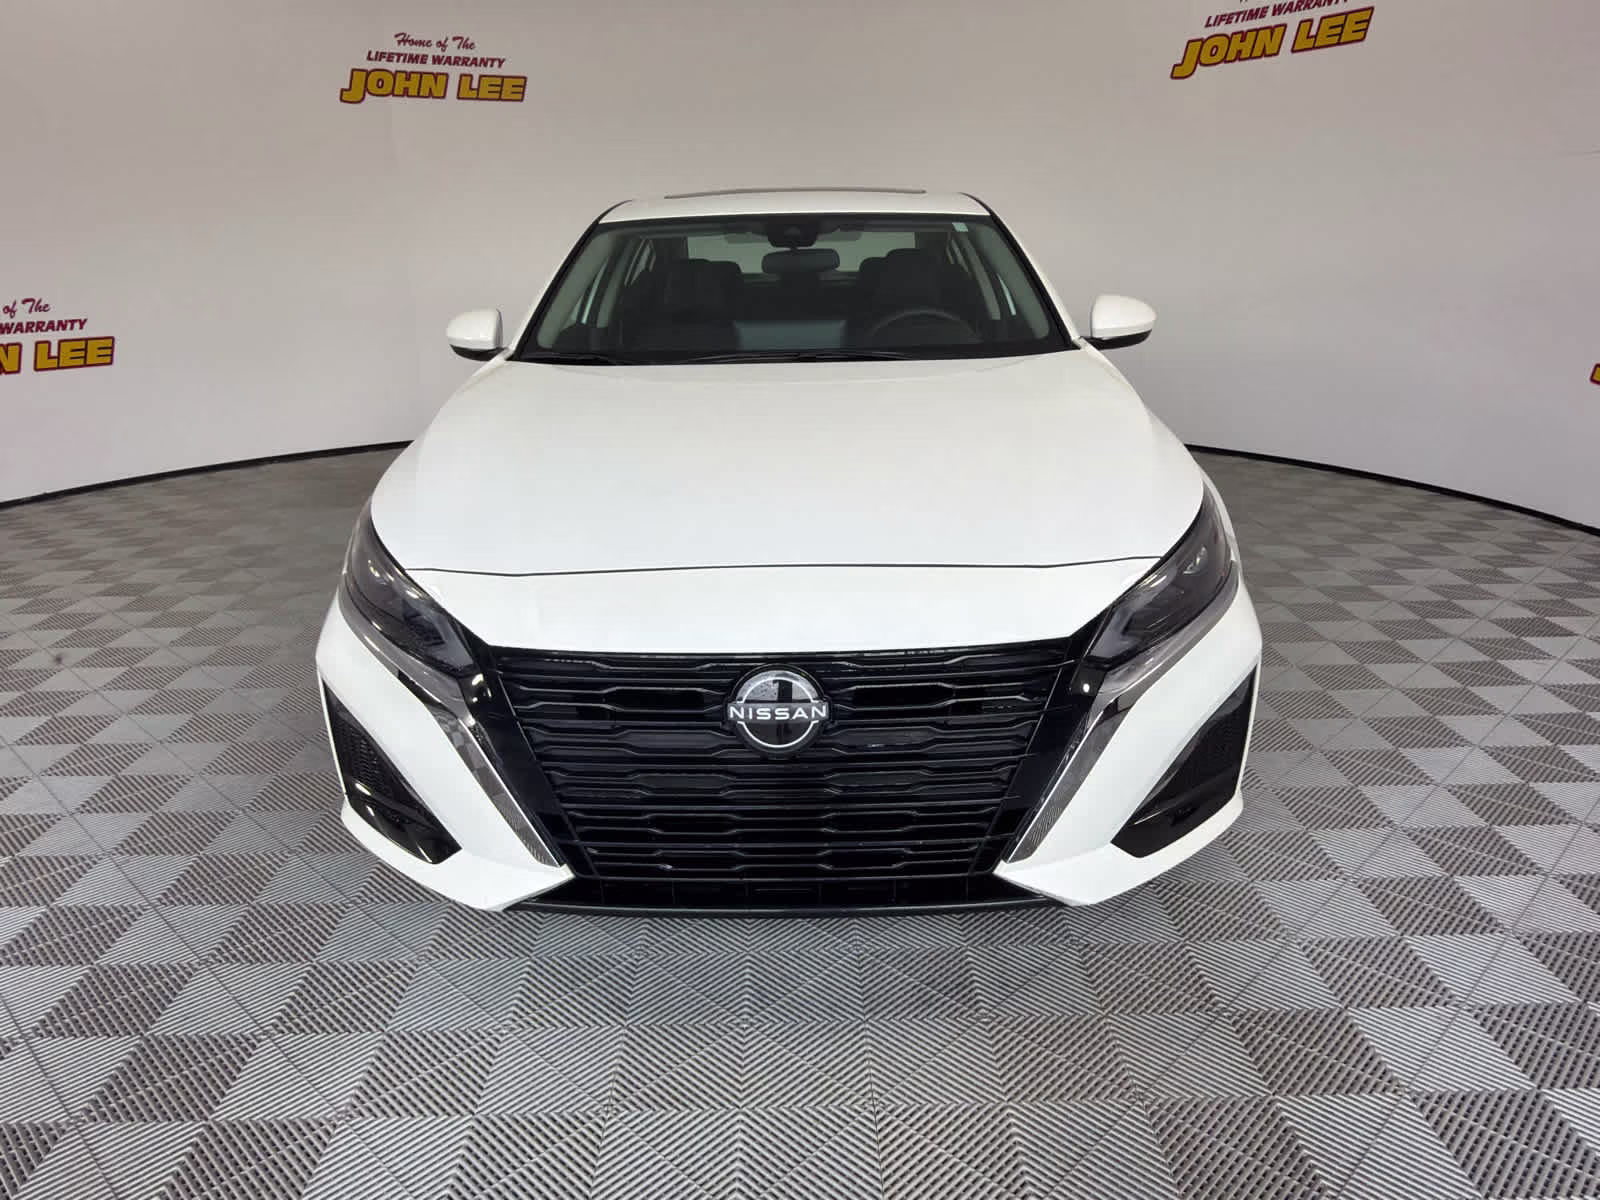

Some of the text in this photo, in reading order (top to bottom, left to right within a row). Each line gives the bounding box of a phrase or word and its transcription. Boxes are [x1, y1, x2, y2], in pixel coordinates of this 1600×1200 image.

[1204, 0, 1348, 28] LIFETIME WARRAN
[394, 32, 475, 52] Home of The
[1170, 6, 1374, 79] JOHN LEE
[366, 50, 505, 68] LIFETIME WARRANTY
[339, 68, 527, 104] JOHN LEE
[2, 298, 51, 319] of The
[0, 318, 88, 335] WARRANTY
[33, 336, 115, 372] LEE
[729, 704, 827, 720] NISSAN
